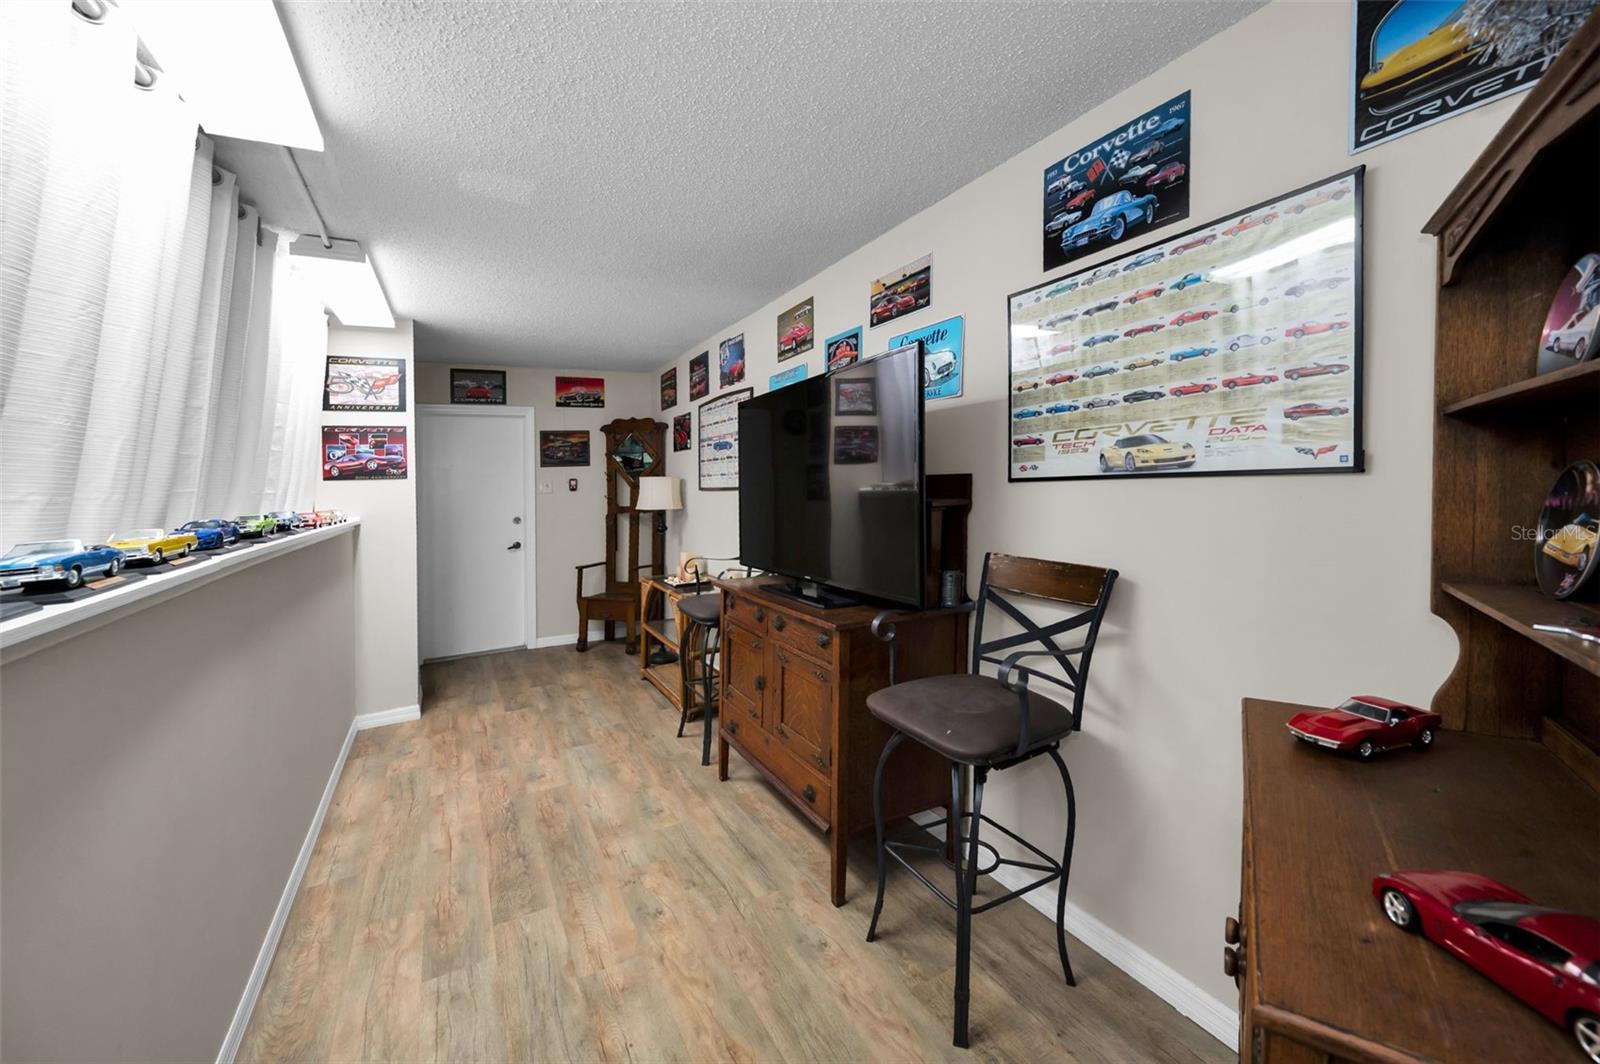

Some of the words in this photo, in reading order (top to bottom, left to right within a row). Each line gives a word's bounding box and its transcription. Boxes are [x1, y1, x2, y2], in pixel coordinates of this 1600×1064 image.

[1360, 52, 1560, 142] CORVETT
[1169, 100, 1186, 114] 1967
[1063, 114, 1160, 173] Corvette
[328, 357, 400, 366] CORVETTE
[1052, 406, 1268, 443] CORVETTE
[1207, 424, 1268, 436] DATA
[1052, 440, 1096, 450] TECH
